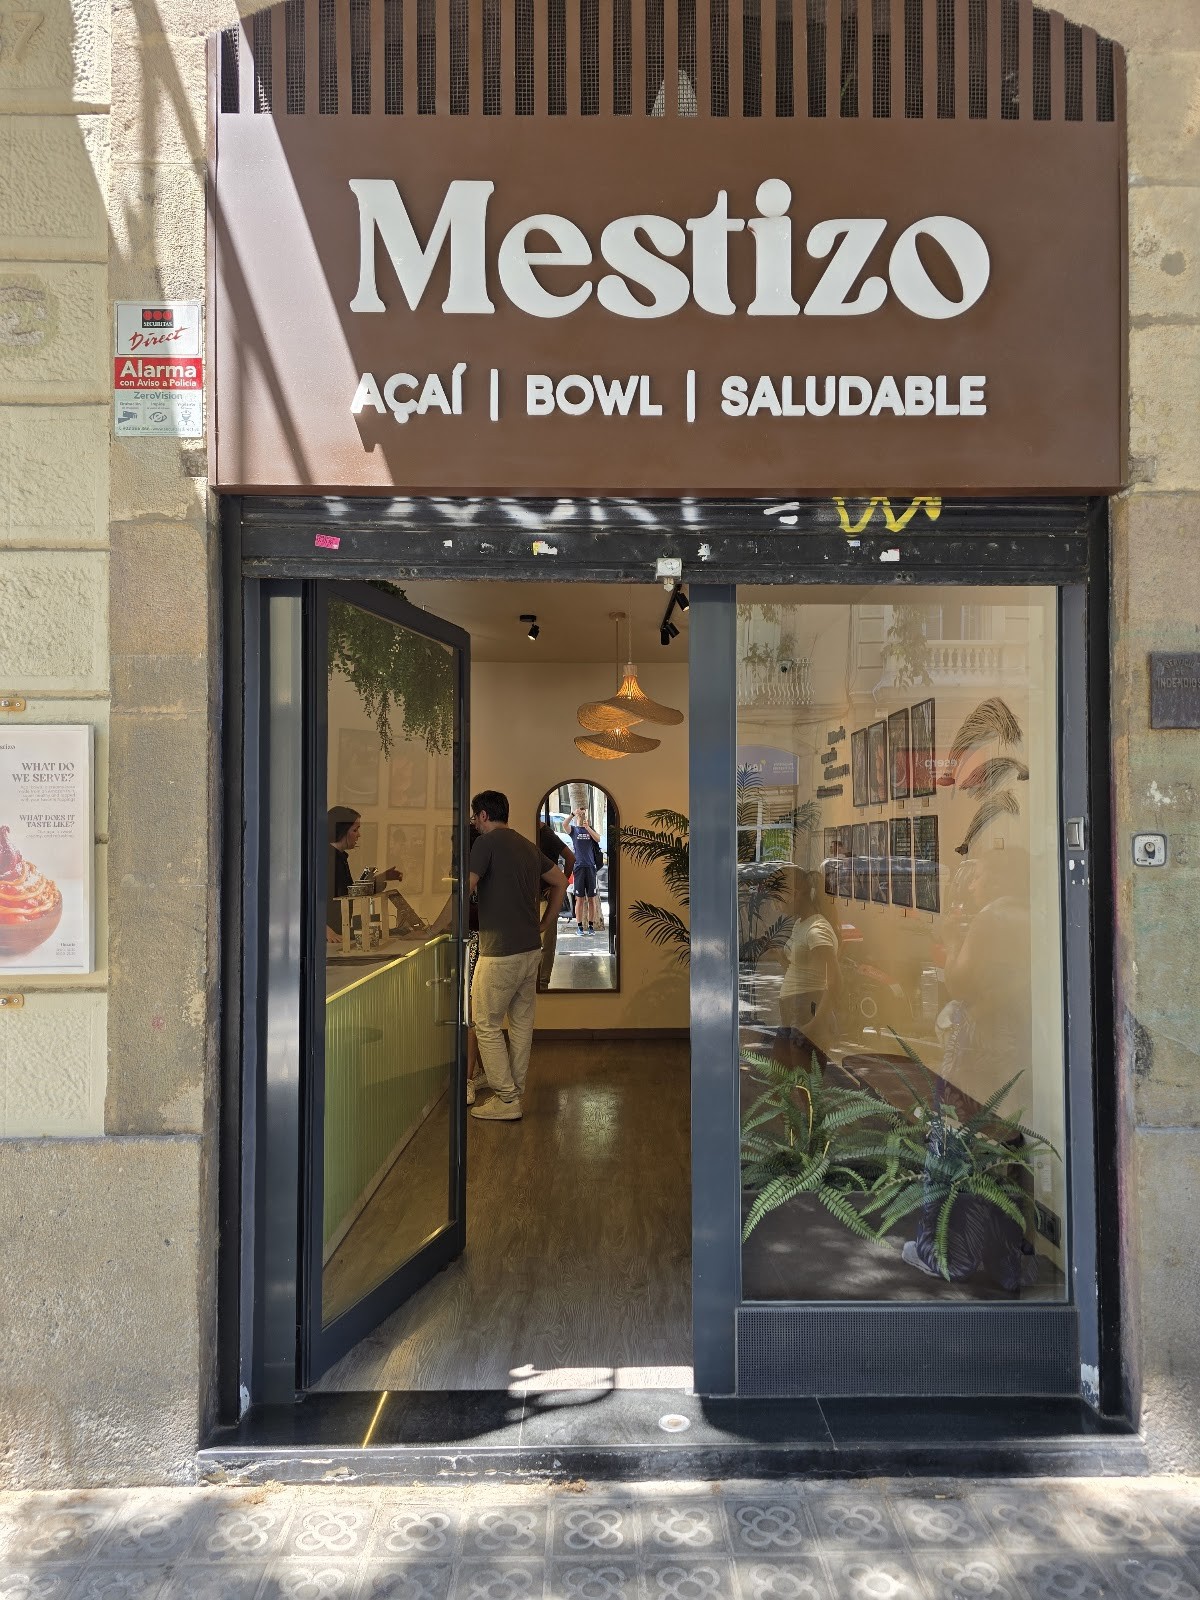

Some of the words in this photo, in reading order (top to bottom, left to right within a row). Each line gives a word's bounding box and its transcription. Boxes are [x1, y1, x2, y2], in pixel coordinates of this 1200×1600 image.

[348, 178, 991, 320] Mestizo
[129, 326, 189, 351] Direct
[120, 360, 197, 377] Alarma
[137, 379, 160, 387] Aviso
[133, 391, 183, 400] ZeroVision
[350, 362, 467, 423] AÇAÍ
[526, 374, 663, 417] BOWL
[720, 375, 988, 418] SALUDABLE
[21, 762, 56, 771] WHAT
[58, 762, 75, 771] DO
[12, 773, 30, 782] WE
[32, 773, 75, 782] SERVE?
